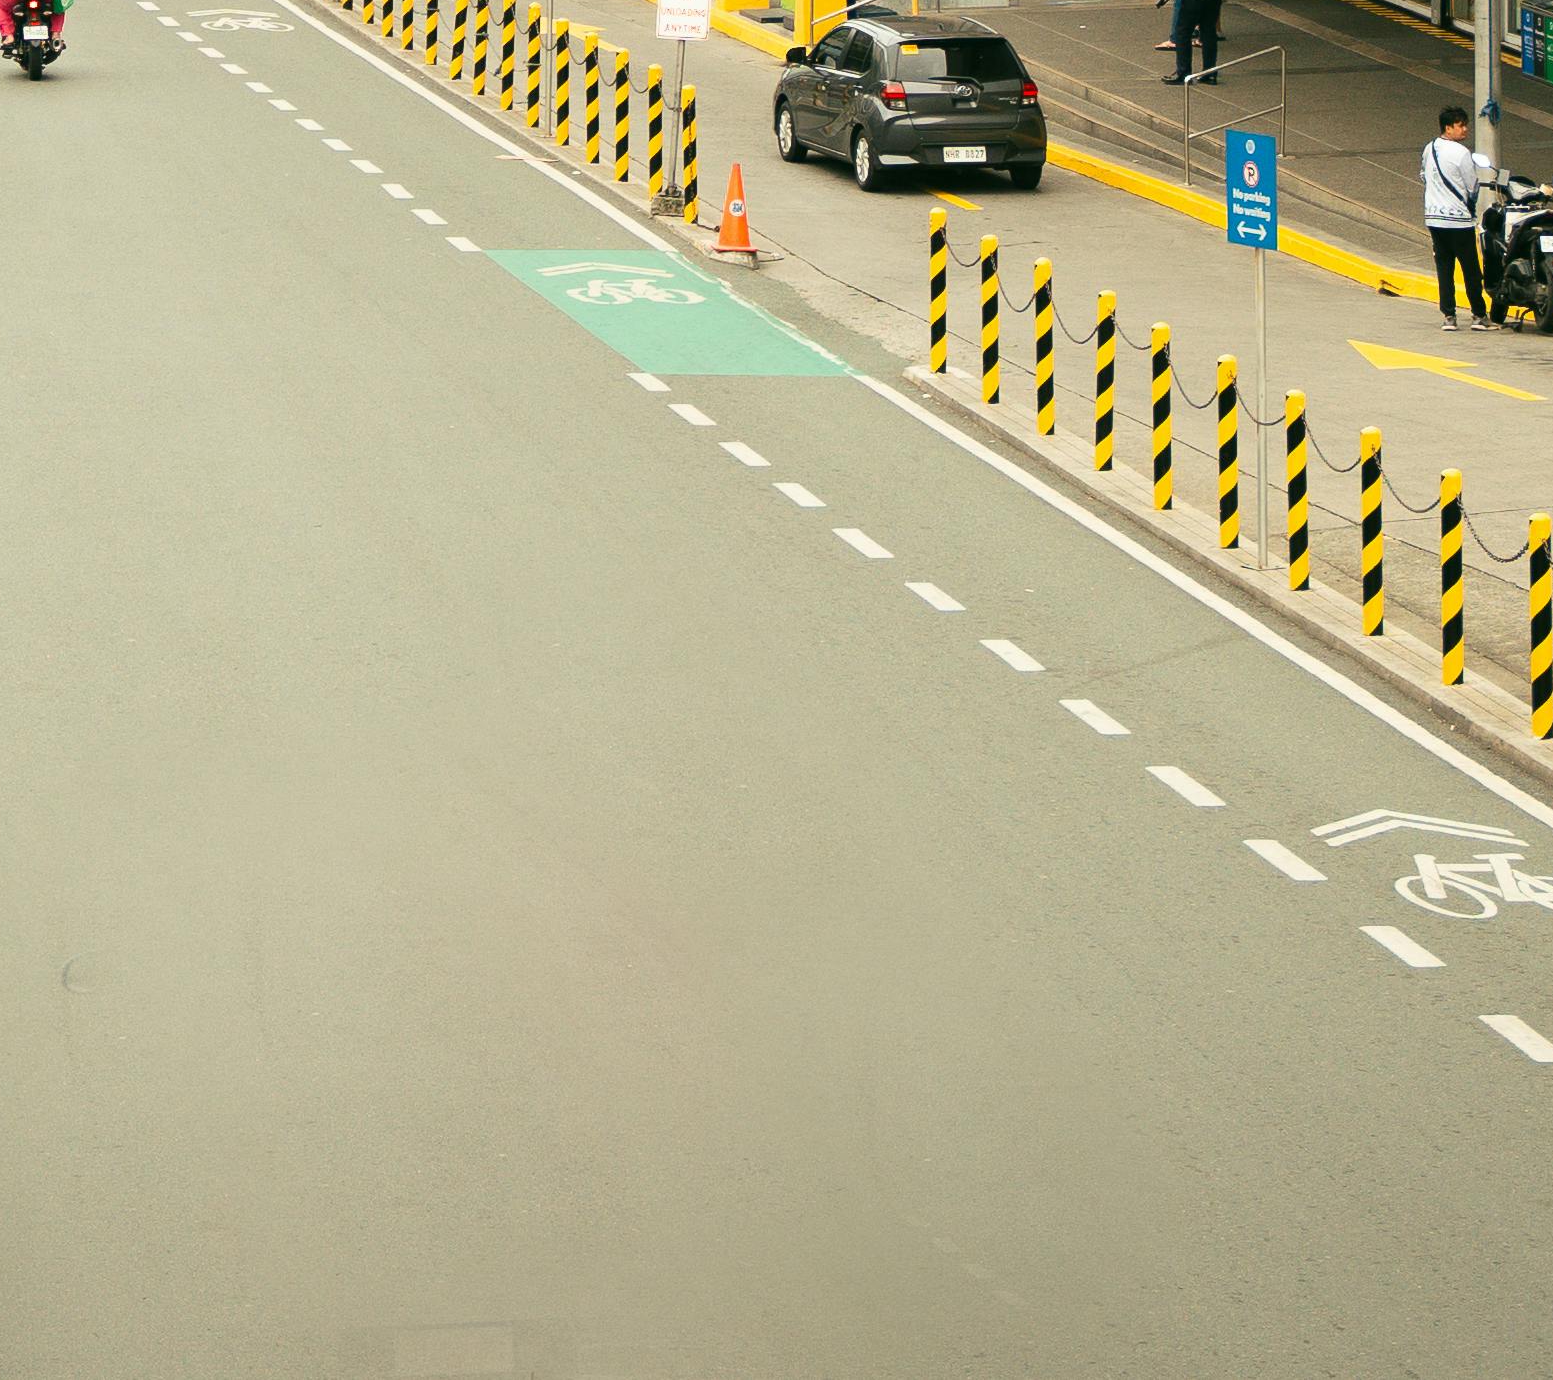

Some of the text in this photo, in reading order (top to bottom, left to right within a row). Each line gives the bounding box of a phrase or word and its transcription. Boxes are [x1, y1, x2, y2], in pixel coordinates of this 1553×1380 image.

[663, 7, 706, 18] UNLOADING
[664, 23, 702, 34] ANYTIME
[1232, 187, 1271, 207] No parking
[1232, 202, 1271, 222] No waiting
